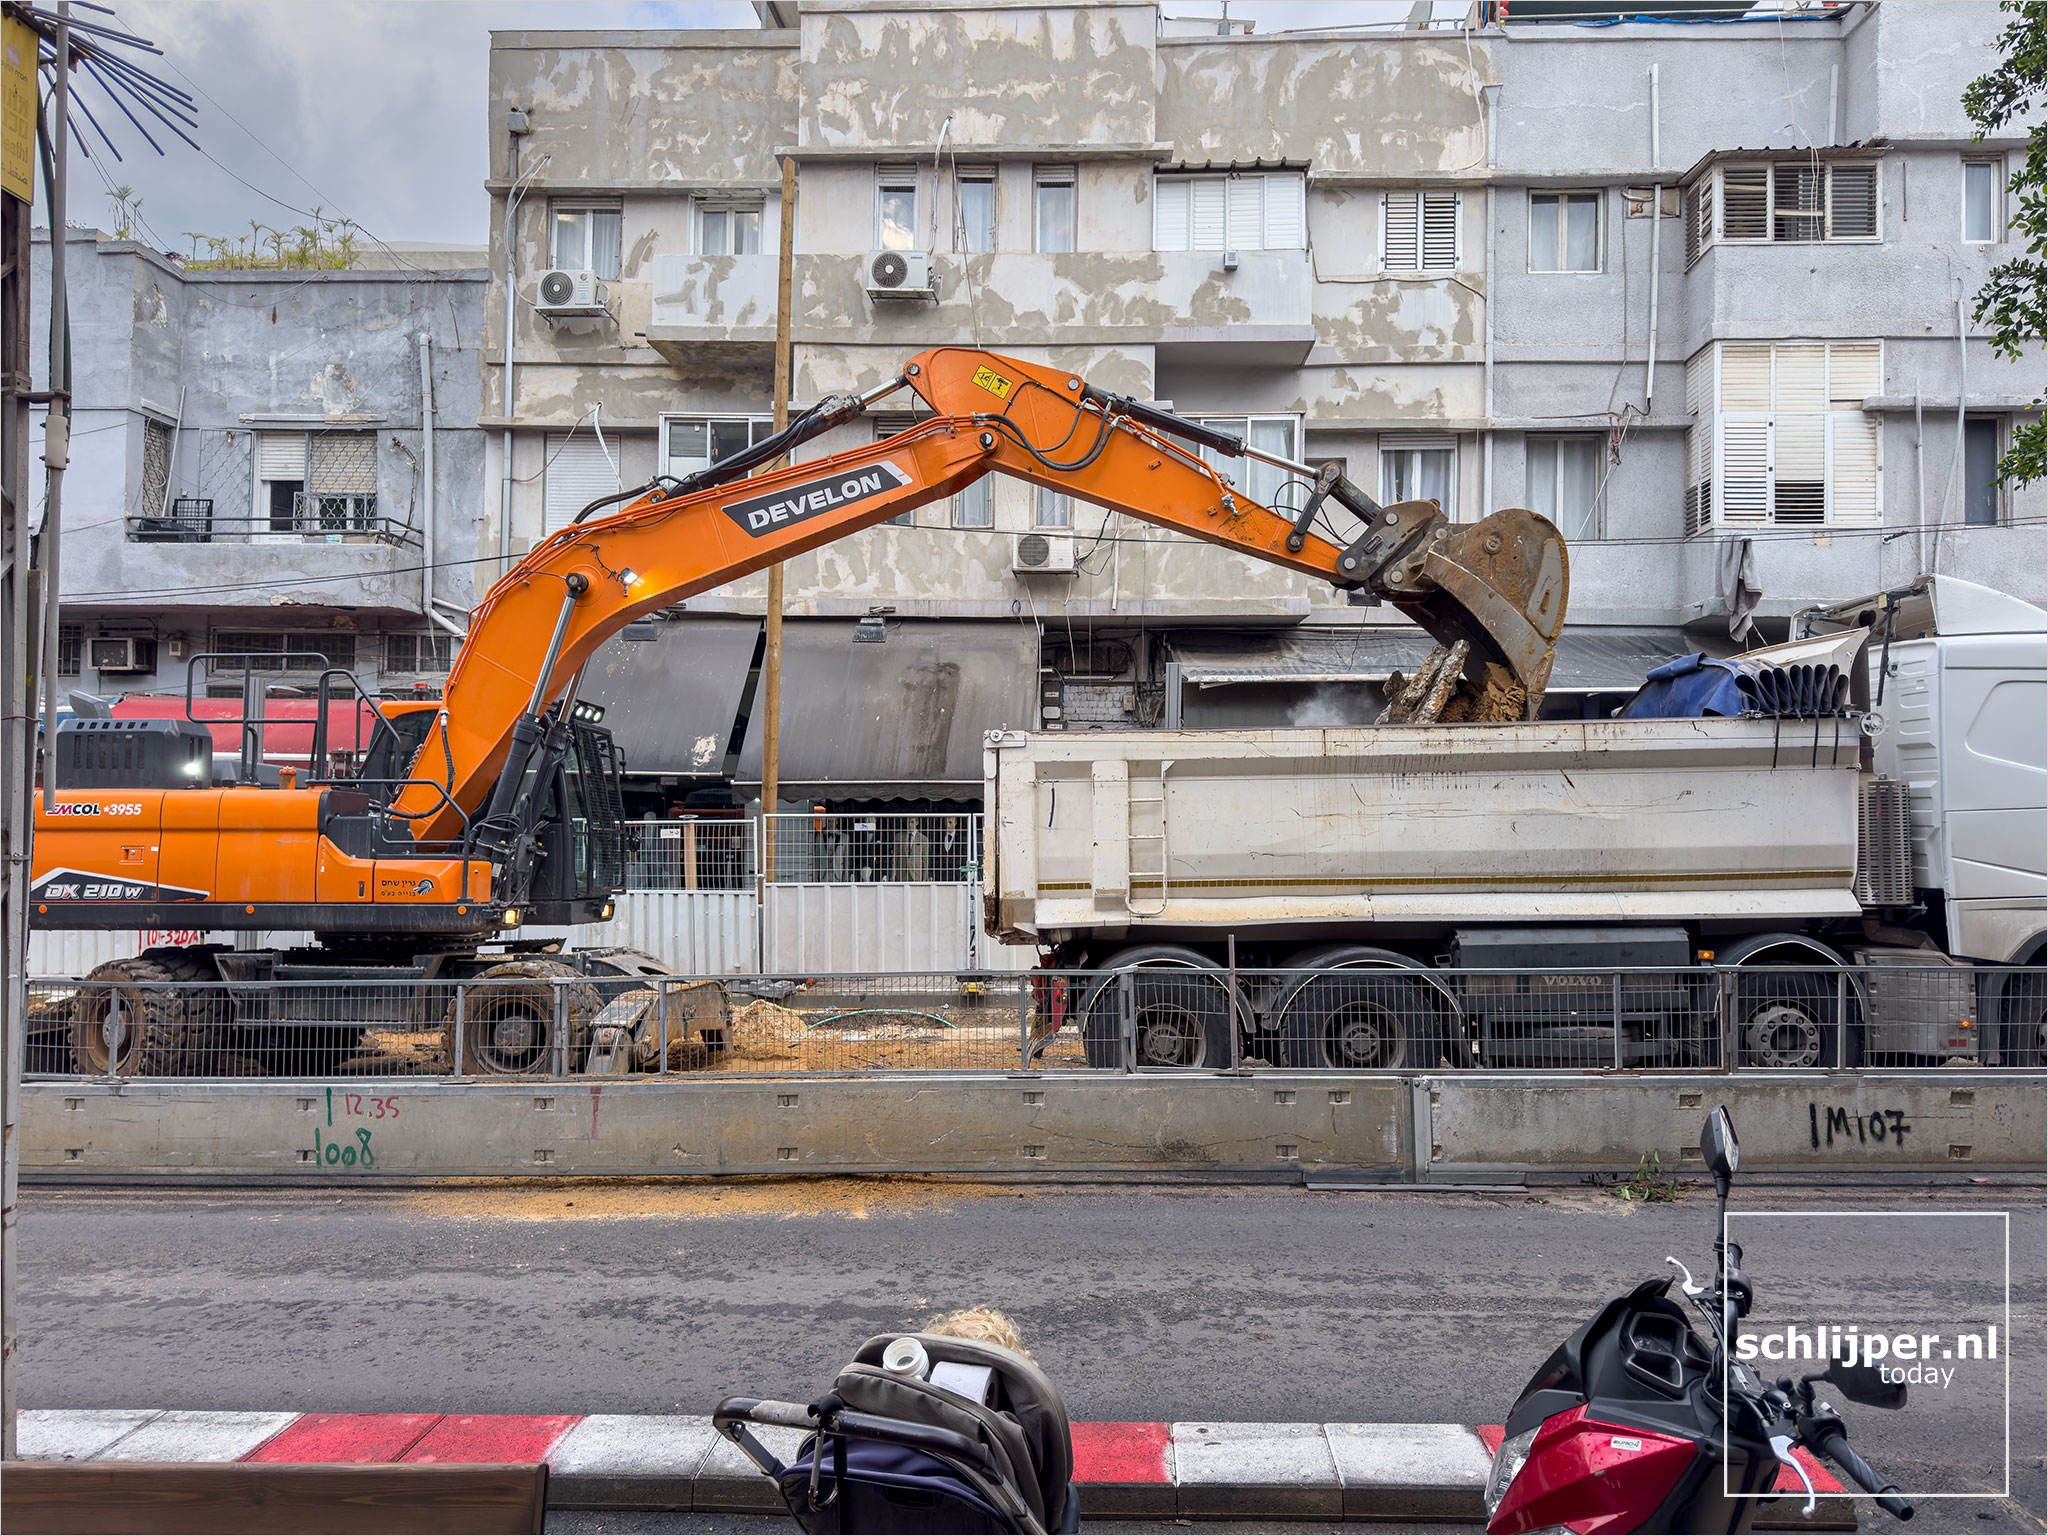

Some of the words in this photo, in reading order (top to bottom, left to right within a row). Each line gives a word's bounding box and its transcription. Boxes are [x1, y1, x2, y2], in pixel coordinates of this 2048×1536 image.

[748, 472, 882, 530] DEVELON
[45, 883, 80, 899] DX
[1542, 975, 1602, 986] VOLVO
